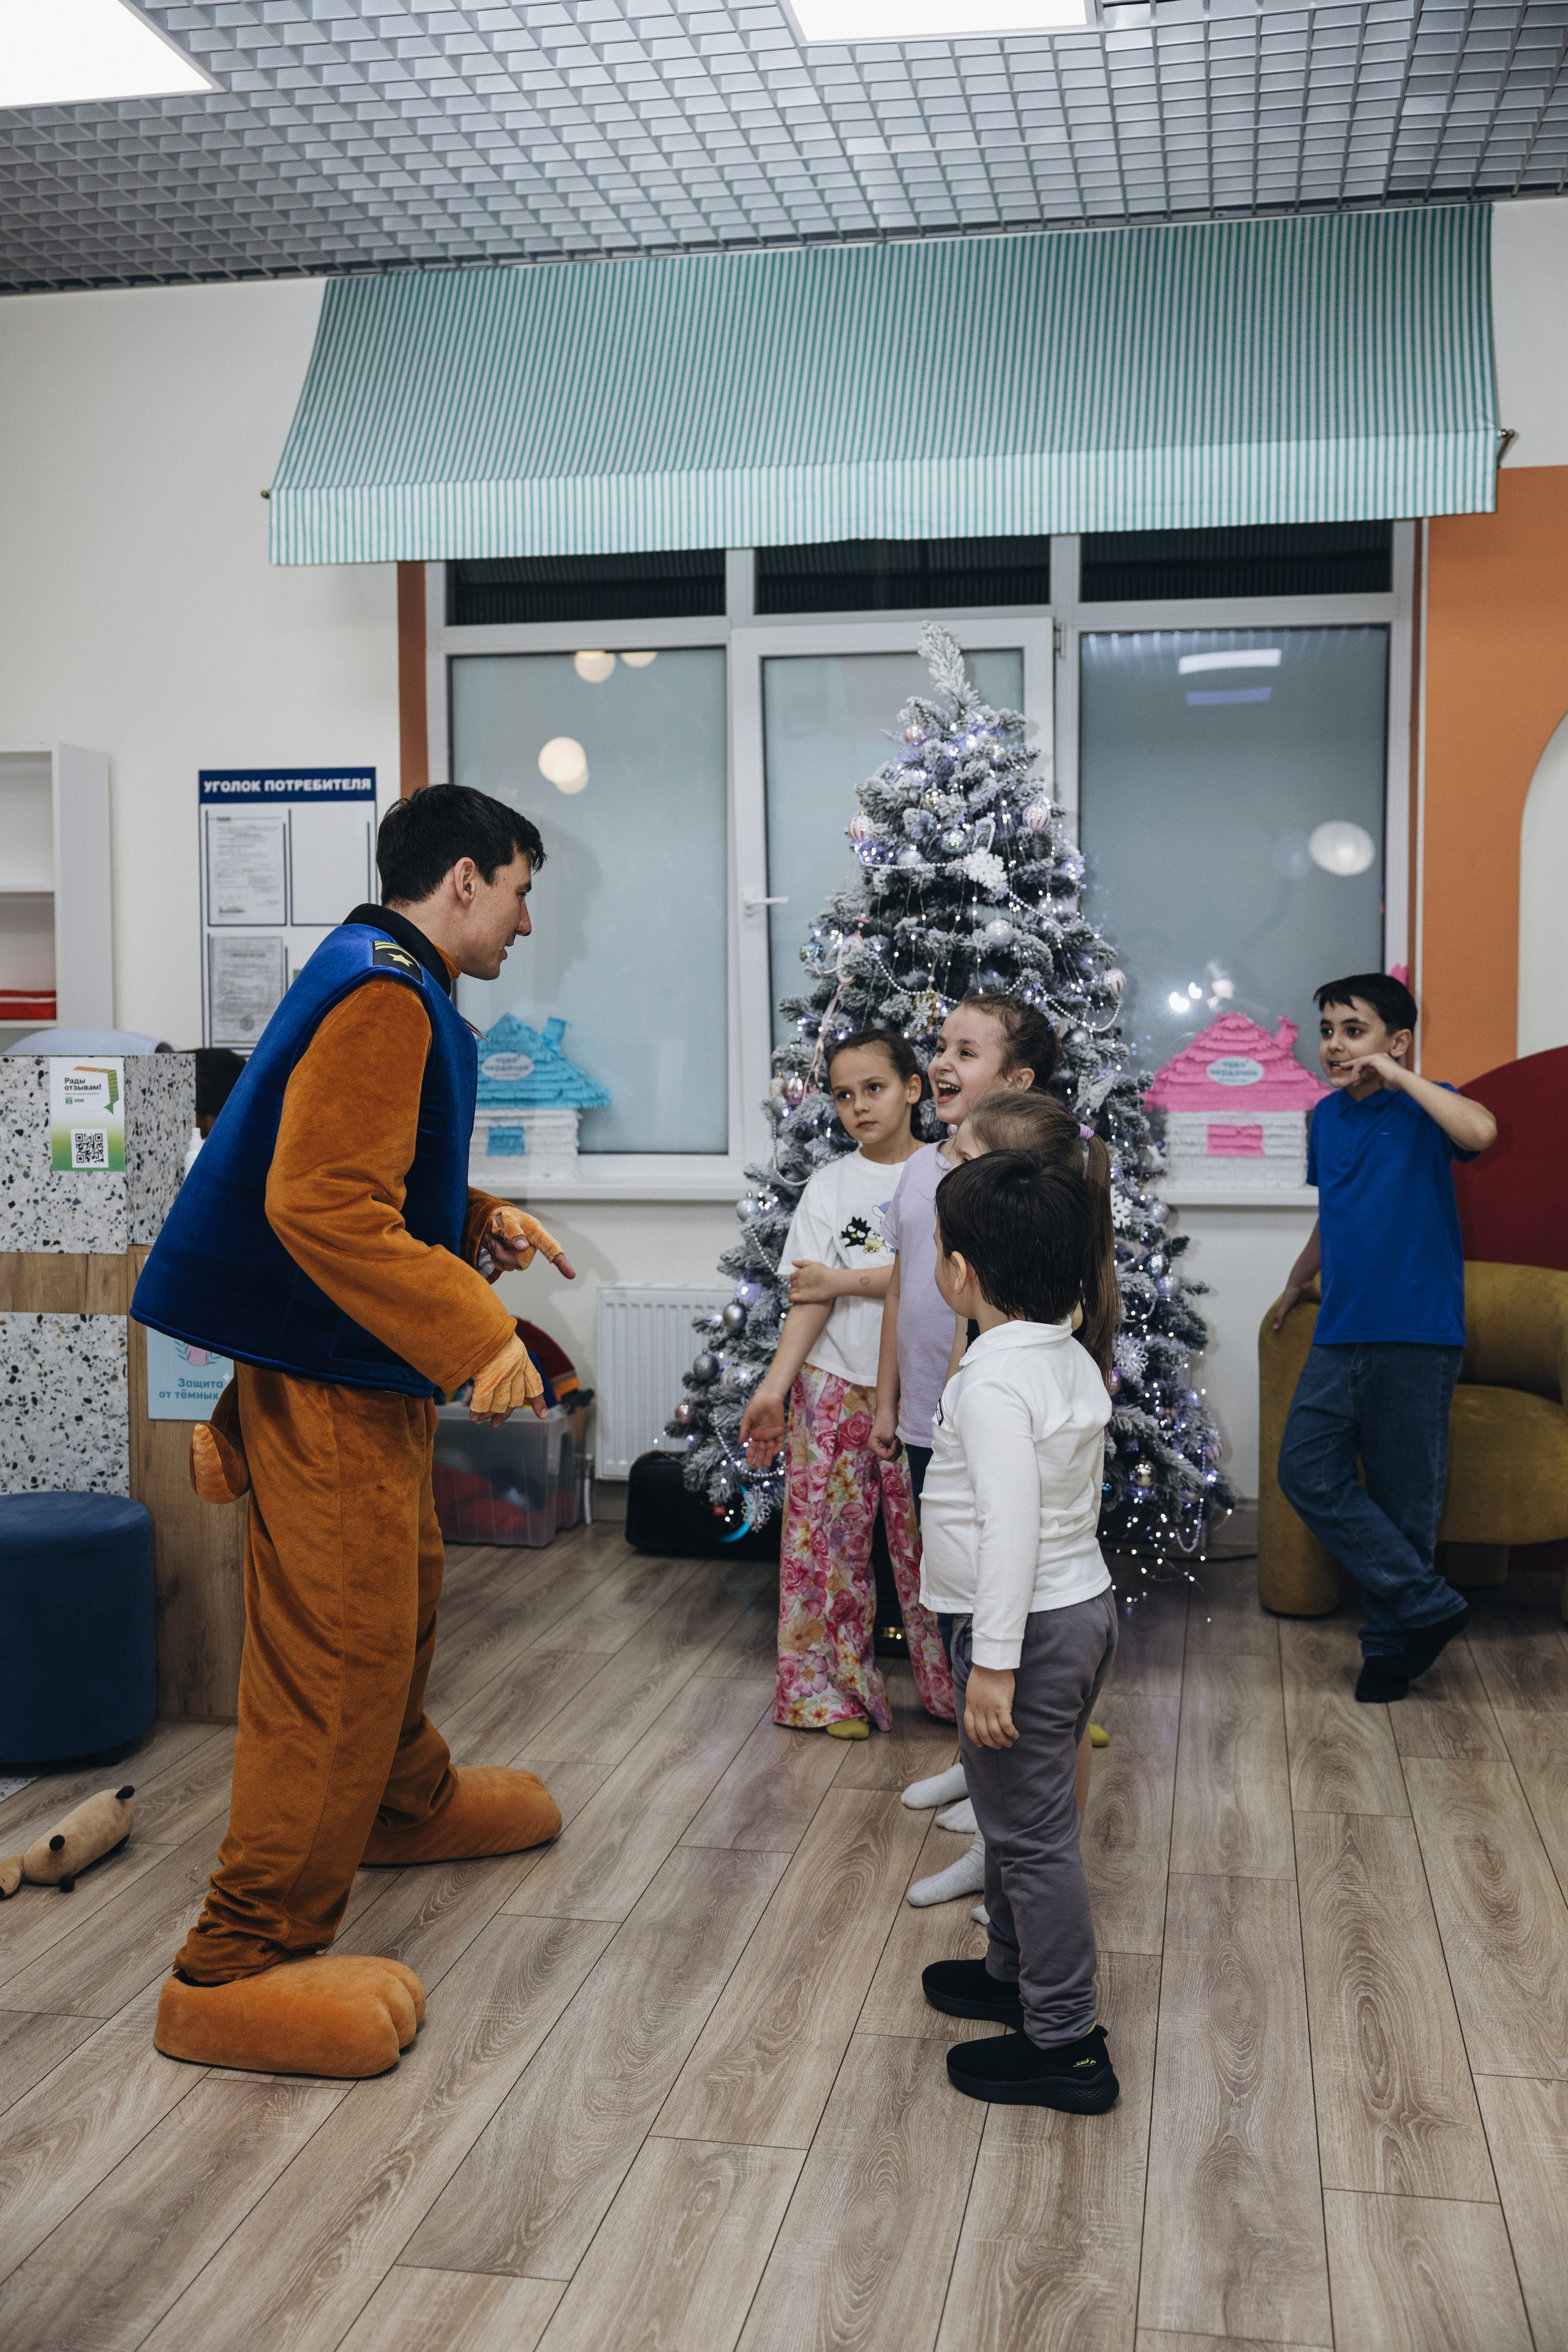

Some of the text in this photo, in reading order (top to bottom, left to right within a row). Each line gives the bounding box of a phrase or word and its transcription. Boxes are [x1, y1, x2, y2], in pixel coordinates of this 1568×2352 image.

[203, 777, 371, 793] УГОЛОК ПОТРЕБИТЕЛЯ
[178, 1378, 223, 1389] Защита
[175, 1389, 219, 1400] тёмных
